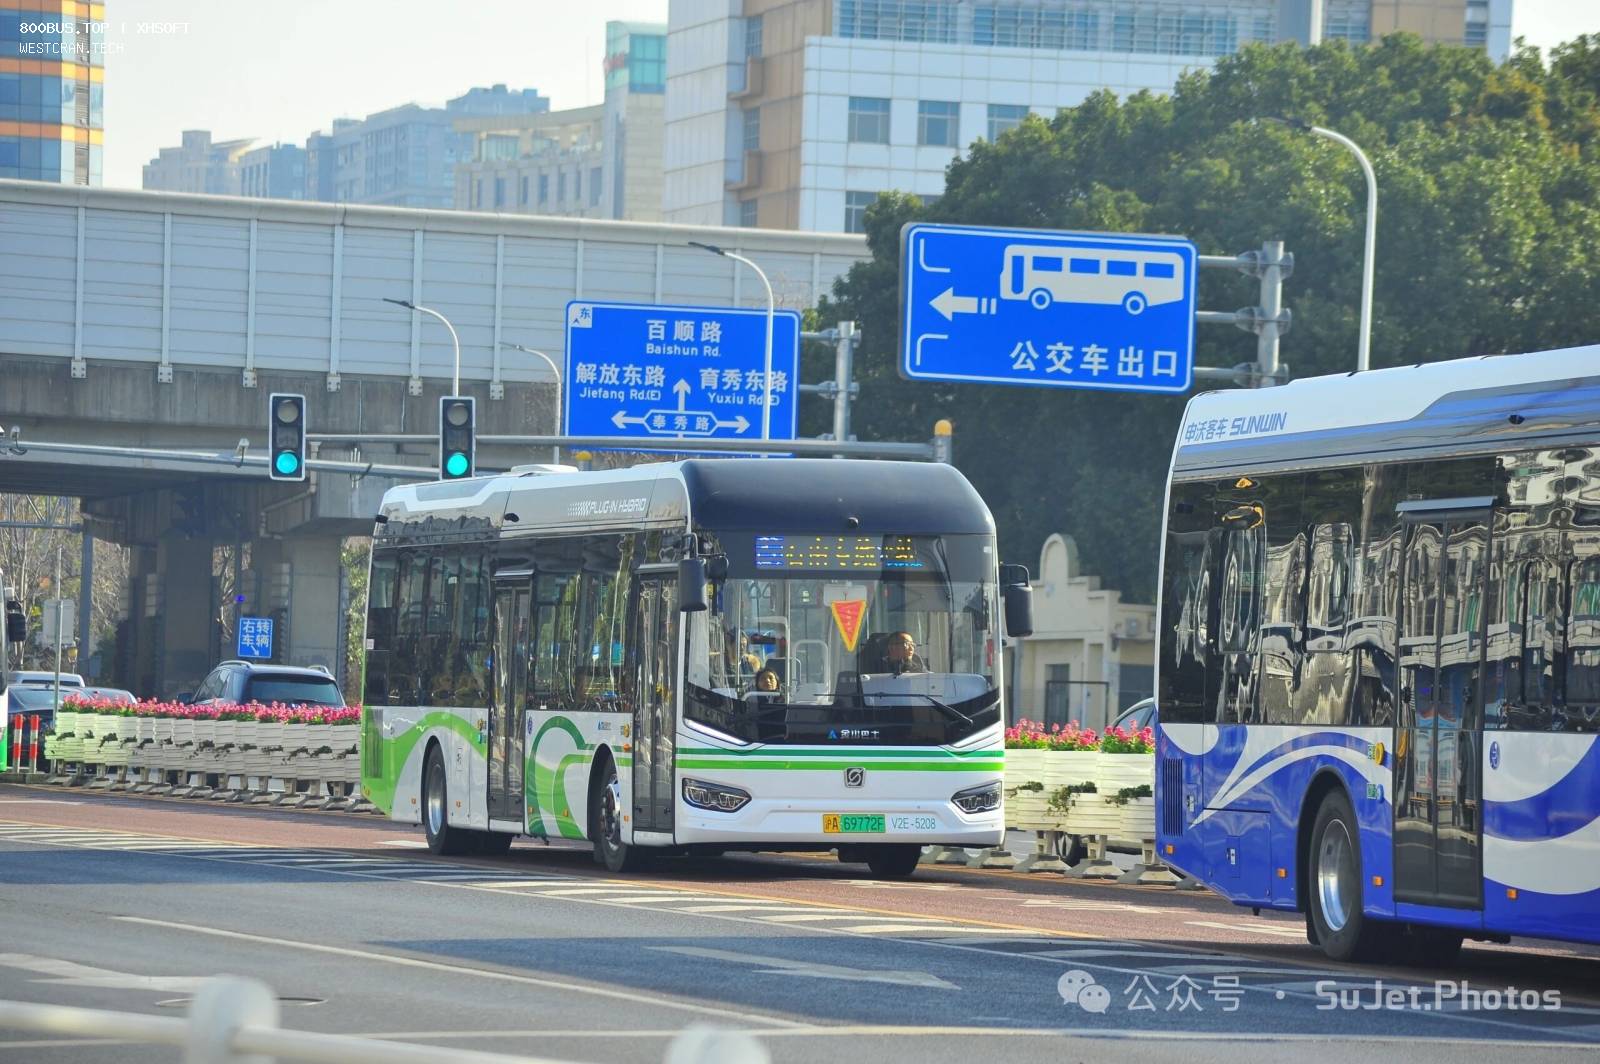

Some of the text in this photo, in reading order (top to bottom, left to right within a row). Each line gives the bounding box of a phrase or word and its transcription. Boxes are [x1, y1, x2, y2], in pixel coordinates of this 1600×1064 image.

[646, 319, 722, 344] 百顺路
[646, 343, 722, 358] Baishun Rd.
[1009, 340, 1177, 378] 公交车出口
[575, 362, 666, 387] 解放东路
[699, 368, 788, 392] 育秀东路
[579, 386, 625, 402] Jiefang
[707, 392, 744, 405] Yuxiu
[1184, 411, 1288, 441] 申沃客车 SUNWIN
[891, 817, 936, 830] V2E-5208
